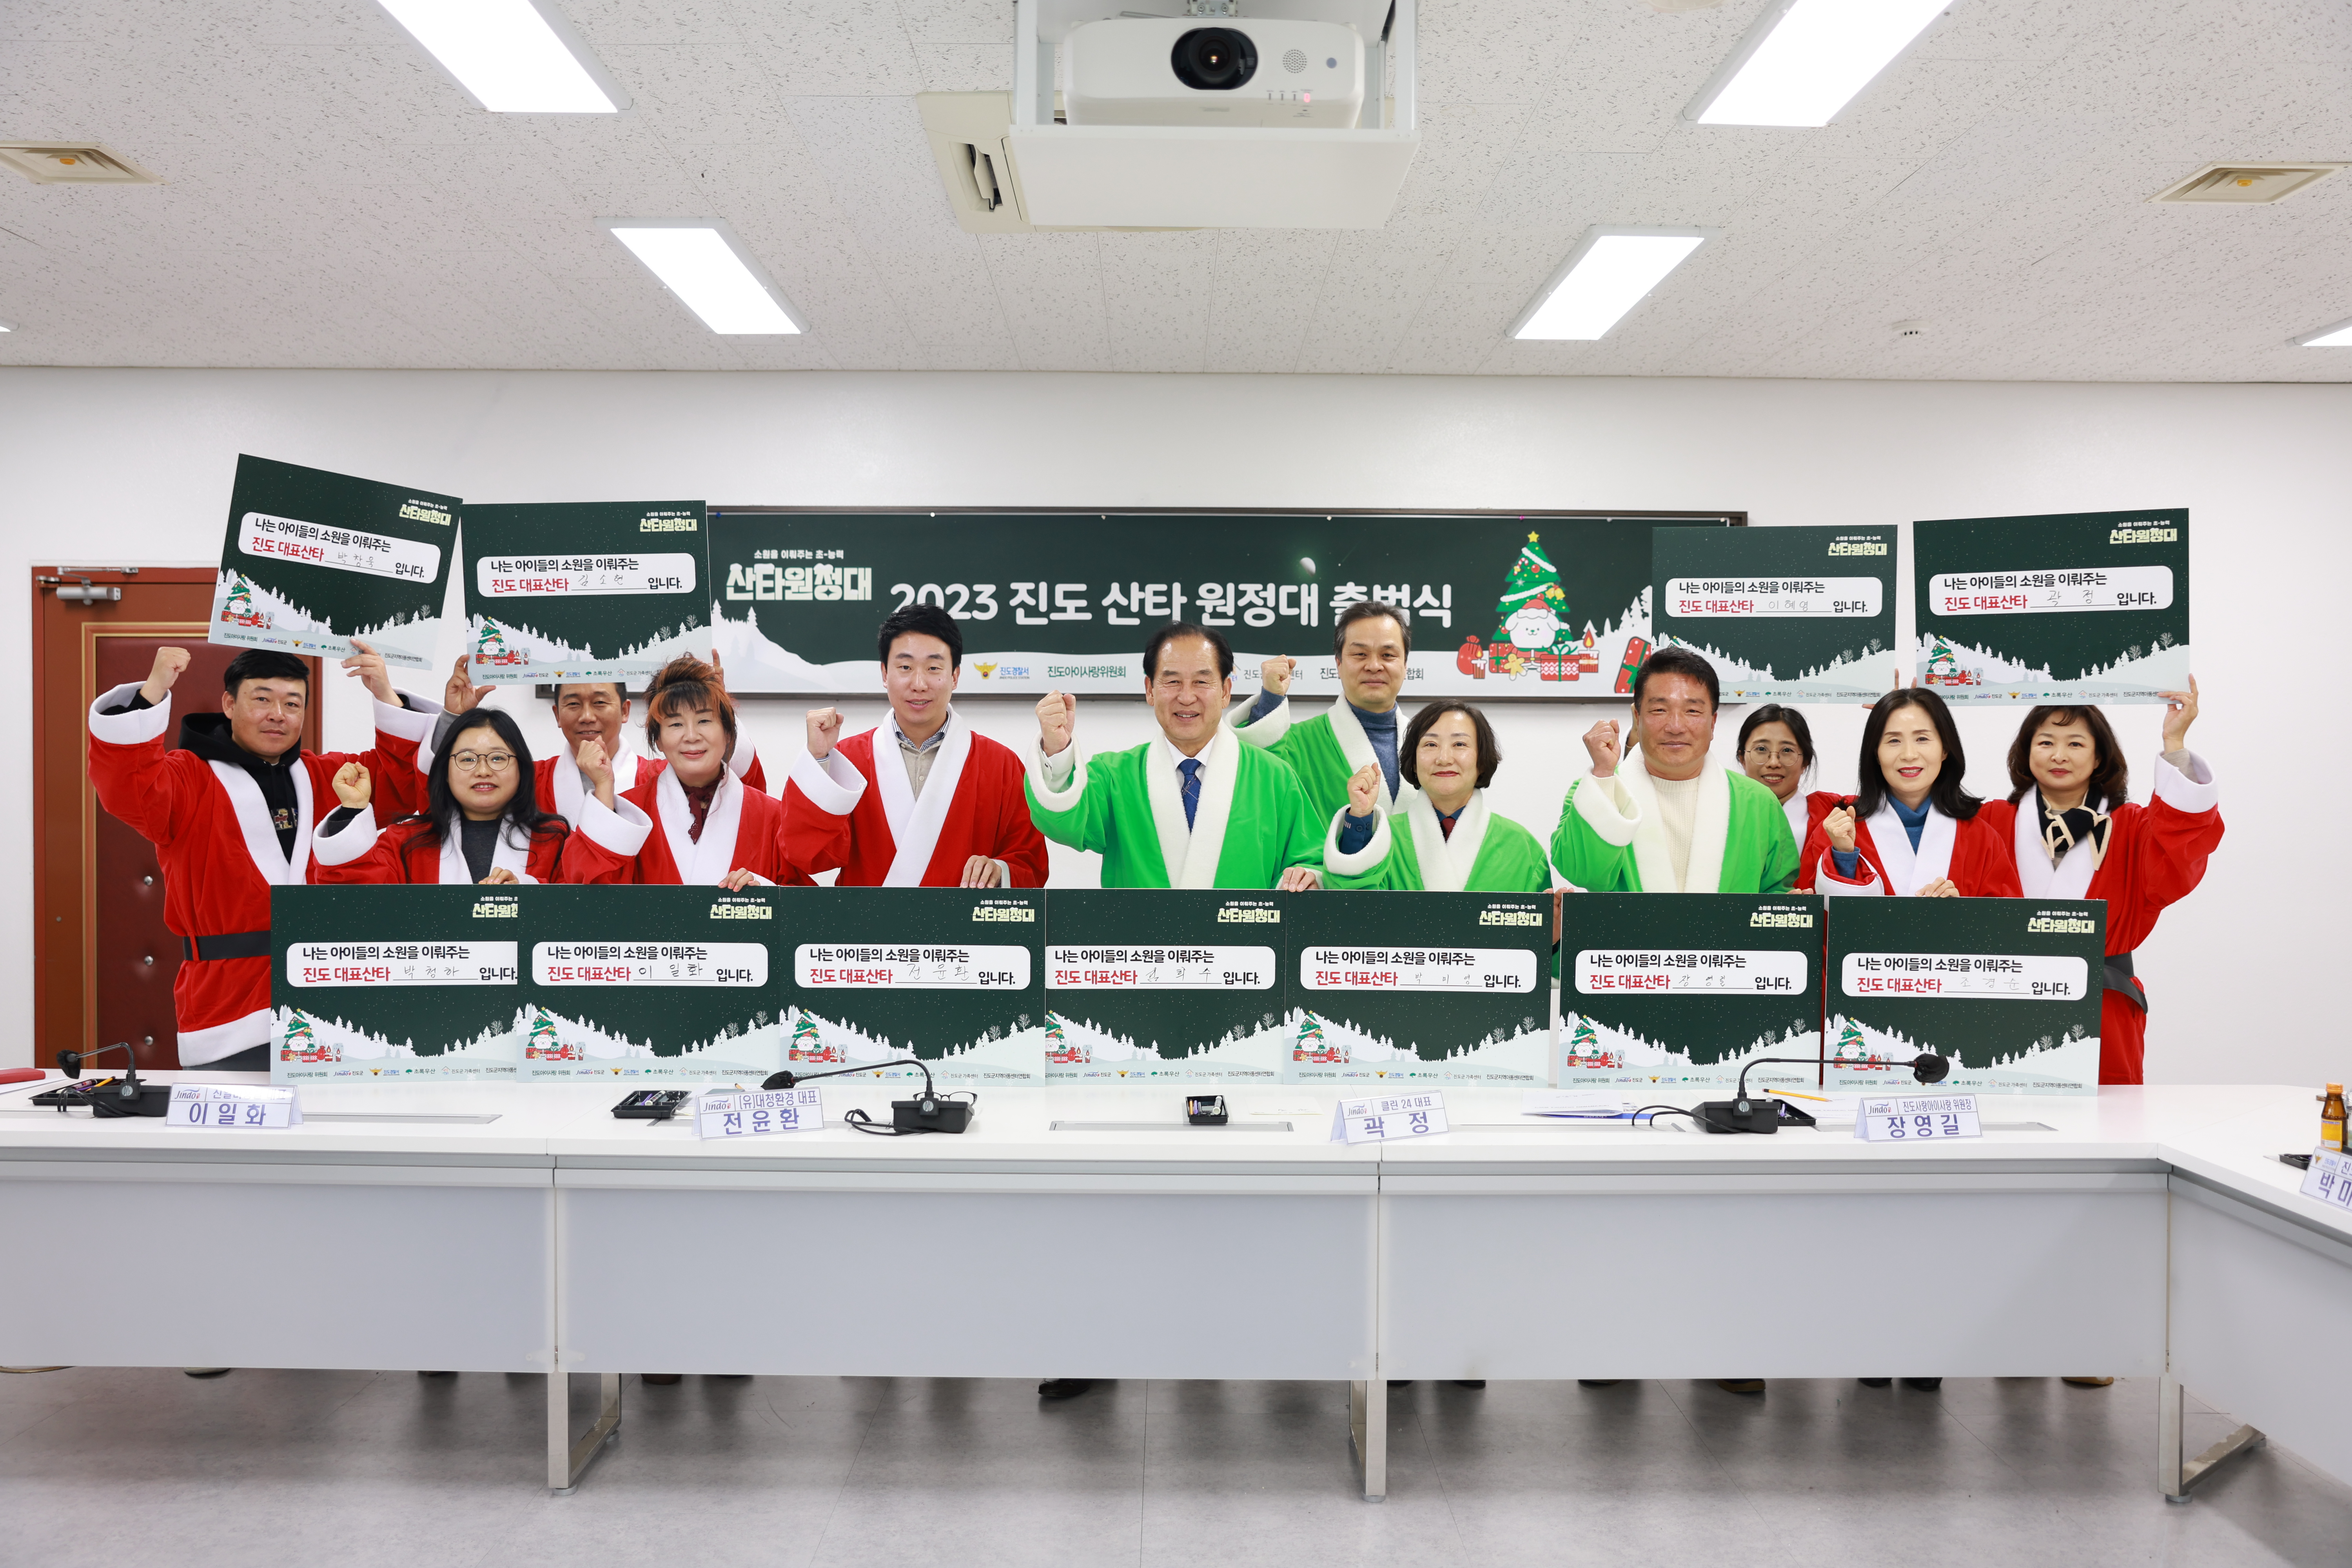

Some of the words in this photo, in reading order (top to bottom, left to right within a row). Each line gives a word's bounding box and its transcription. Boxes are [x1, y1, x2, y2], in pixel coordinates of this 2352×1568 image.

[399, 504, 452, 526] 산타원정대
[639, 517, 697, 532] 산타원정대
[255, 517, 276, 532] 나는
[278, 522, 319, 540] 아이들의
[320, 530, 350, 545] 소원을
[352, 535, 391, 552] 이뤄주는
[2109, 527, 2177, 544] 산타원정대
[754, 550, 778, 559] 소원을
[781, 550, 813, 559] 이뤄주는
[815, 550, 844, 559] 초-능력
[1828, 541, 1887, 556] 산타원정대
[252, 537, 275, 553] 진도
[278, 541, 325, 562] 대표산타
[395, 563, 425, 578] 입니다.
[492, 561, 513, 573] 나는
[515, 559, 558, 572] 아이들의
[561, 559, 593, 571] 소원을
[596, 557, 639, 571] 이뤄주는
[492, 579, 517, 593] 진도
[520, 578, 569, 592] 대표산타
[648, 577, 682, 590] 입니다.
[726, 563, 872, 601] 산타원정대
[1680, 582, 1700, 594] 나는
[1703, 581, 1744, 594] 아이들의
[1748, 581, 1780, 593] 소원을
[1782, 581, 1825, 593] 이뤄주는
[1945, 577, 1967, 591] 나는
[1970, 575, 2016, 590] 아이들의
[2020, 573, 2056, 588] 소원을
[2058, 572, 2107, 586] 이뤄주는
[890, 583, 998, 620] 2023
[1009, 581, 1092, 625] 진도
[1101, 582, 1188, 625] 산타
[1195, 582, 1318, 627] 원정대
[1679, 600, 1702, 613] 진도
[1706, 600, 1754, 613] 대표산타
[1833, 601, 1867, 613] 입니다.
[1945, 597, 1971, 611] 진도
[1974, 595, 2028, 610] 대표산타
[2117, 592, 2156, 606] 입니다.
[1000, 667, 1029, 675] 진도경찰서
[1047, 666, 1126, 678] 진도아이사랑위원회
[710, 904, 771, 919] 산타원정대
[972, 907, 1034, 922] 산타원정대
[1218, 907, 1279, 922] 산타원정대
[1479, 911, 1542, 926] 산타원정대
[1750, 912, 1813, 927] 산타원정대
[2027, 917, 2094, 933] 산타원정대
[303, 947, 328, 960] 나는
[331, 946, 379, 960] 아이들의
[383, 946, 419, 960] 소원을
[422, 946, 470, 959] 이뤄주는
[548, 946, 572, 959] 나는
[574, 946, 620, 959] 아이들의
[623, 946, 659, 960] 소원을
[661, 947, 707, 960] 이뤄주는
[811, 948, 833, 961] 나는
[836, 948, 882, 962] 아이들의
[886, 949, 920, 962] 소원을
[923, 949, 969, 962] 이뤄주는
[1055, 950, 1078, 963] 나는
[1081, 950, 1127, 963] 아이들의
[1131, 950, 1165, 963] 소원을
[1168, 950, 1214, 963] 이뤄주는
[1316, 951, 1339, 964] 나는
[1342, 951, 1388, 964] 아이들의
[1391, 952, 1426, 965] 소원을
[1429, 953, 1475, 965] 이뤄주는
[1590, 955, 1613, 967] 나는
[1615, 954, 1660, 967] 아이들의
[1664, 954, 1698, 967] 소원을
[1700, 954, 1746, 967] 이뤄주는
[1858, 958, 1882, 971] 나는
[1884, 958, 1932, 971] 아이들의
[1935, 958, 1971, 971] 소원을
[1974, 959, 2023, 972] 이뤄주는
[303, 967, 331, 982] 진도
[335, 967, 390, 982] 대표산타
[548, 967, 574, 981] 진도
[578, 967, 631, 981] 대표산타
[717, 969, 753, 982] 입니다.
[811, 969, 836, 983] 진도
[840, 969, 893, 984] 대표산타
[978, 972, 1015, 985] 입니다.
[1055, 971, 1081, 985] 진도
[1085, 970, 1138, 985] 대표산타
[1223, 972, 1260, 985] 입니다.
[1316, 971, 1342, 985] 진도
[1345, 971, 1398, 986] 대표산타
[1484, 975, 1521, 988] 입니다.
[1590, 975, 1615, 989] 진도
[1619, 975, 1671, 989] 대표산타
[1755, 976, 1791, 989] 입니다.
[1857, 978, 1884, 992] 진도
[1887, 978, 1942, 993] 대표산타
[2031, 982, 2070, 995] 입니다.
[174, 1091, 196, 1099] Jindo
[798, 1090, 817, 1104] 대표
[703, 1103, 726, 1112] Jindo
[1348, 1107, 1364, 1116] Jindo
[1381, 1100, 1399, 1111] 클린
[1401, 1099, 1412, 1109] 24
[1414, 1097, 1432, 1107] 대표
[1868, 1106, 1887, 1114] Jindo
[1903, 1100, 1951, 1112] 진도사랑아이사랑
[1953, 1099, 1971, 1110] 위원장
